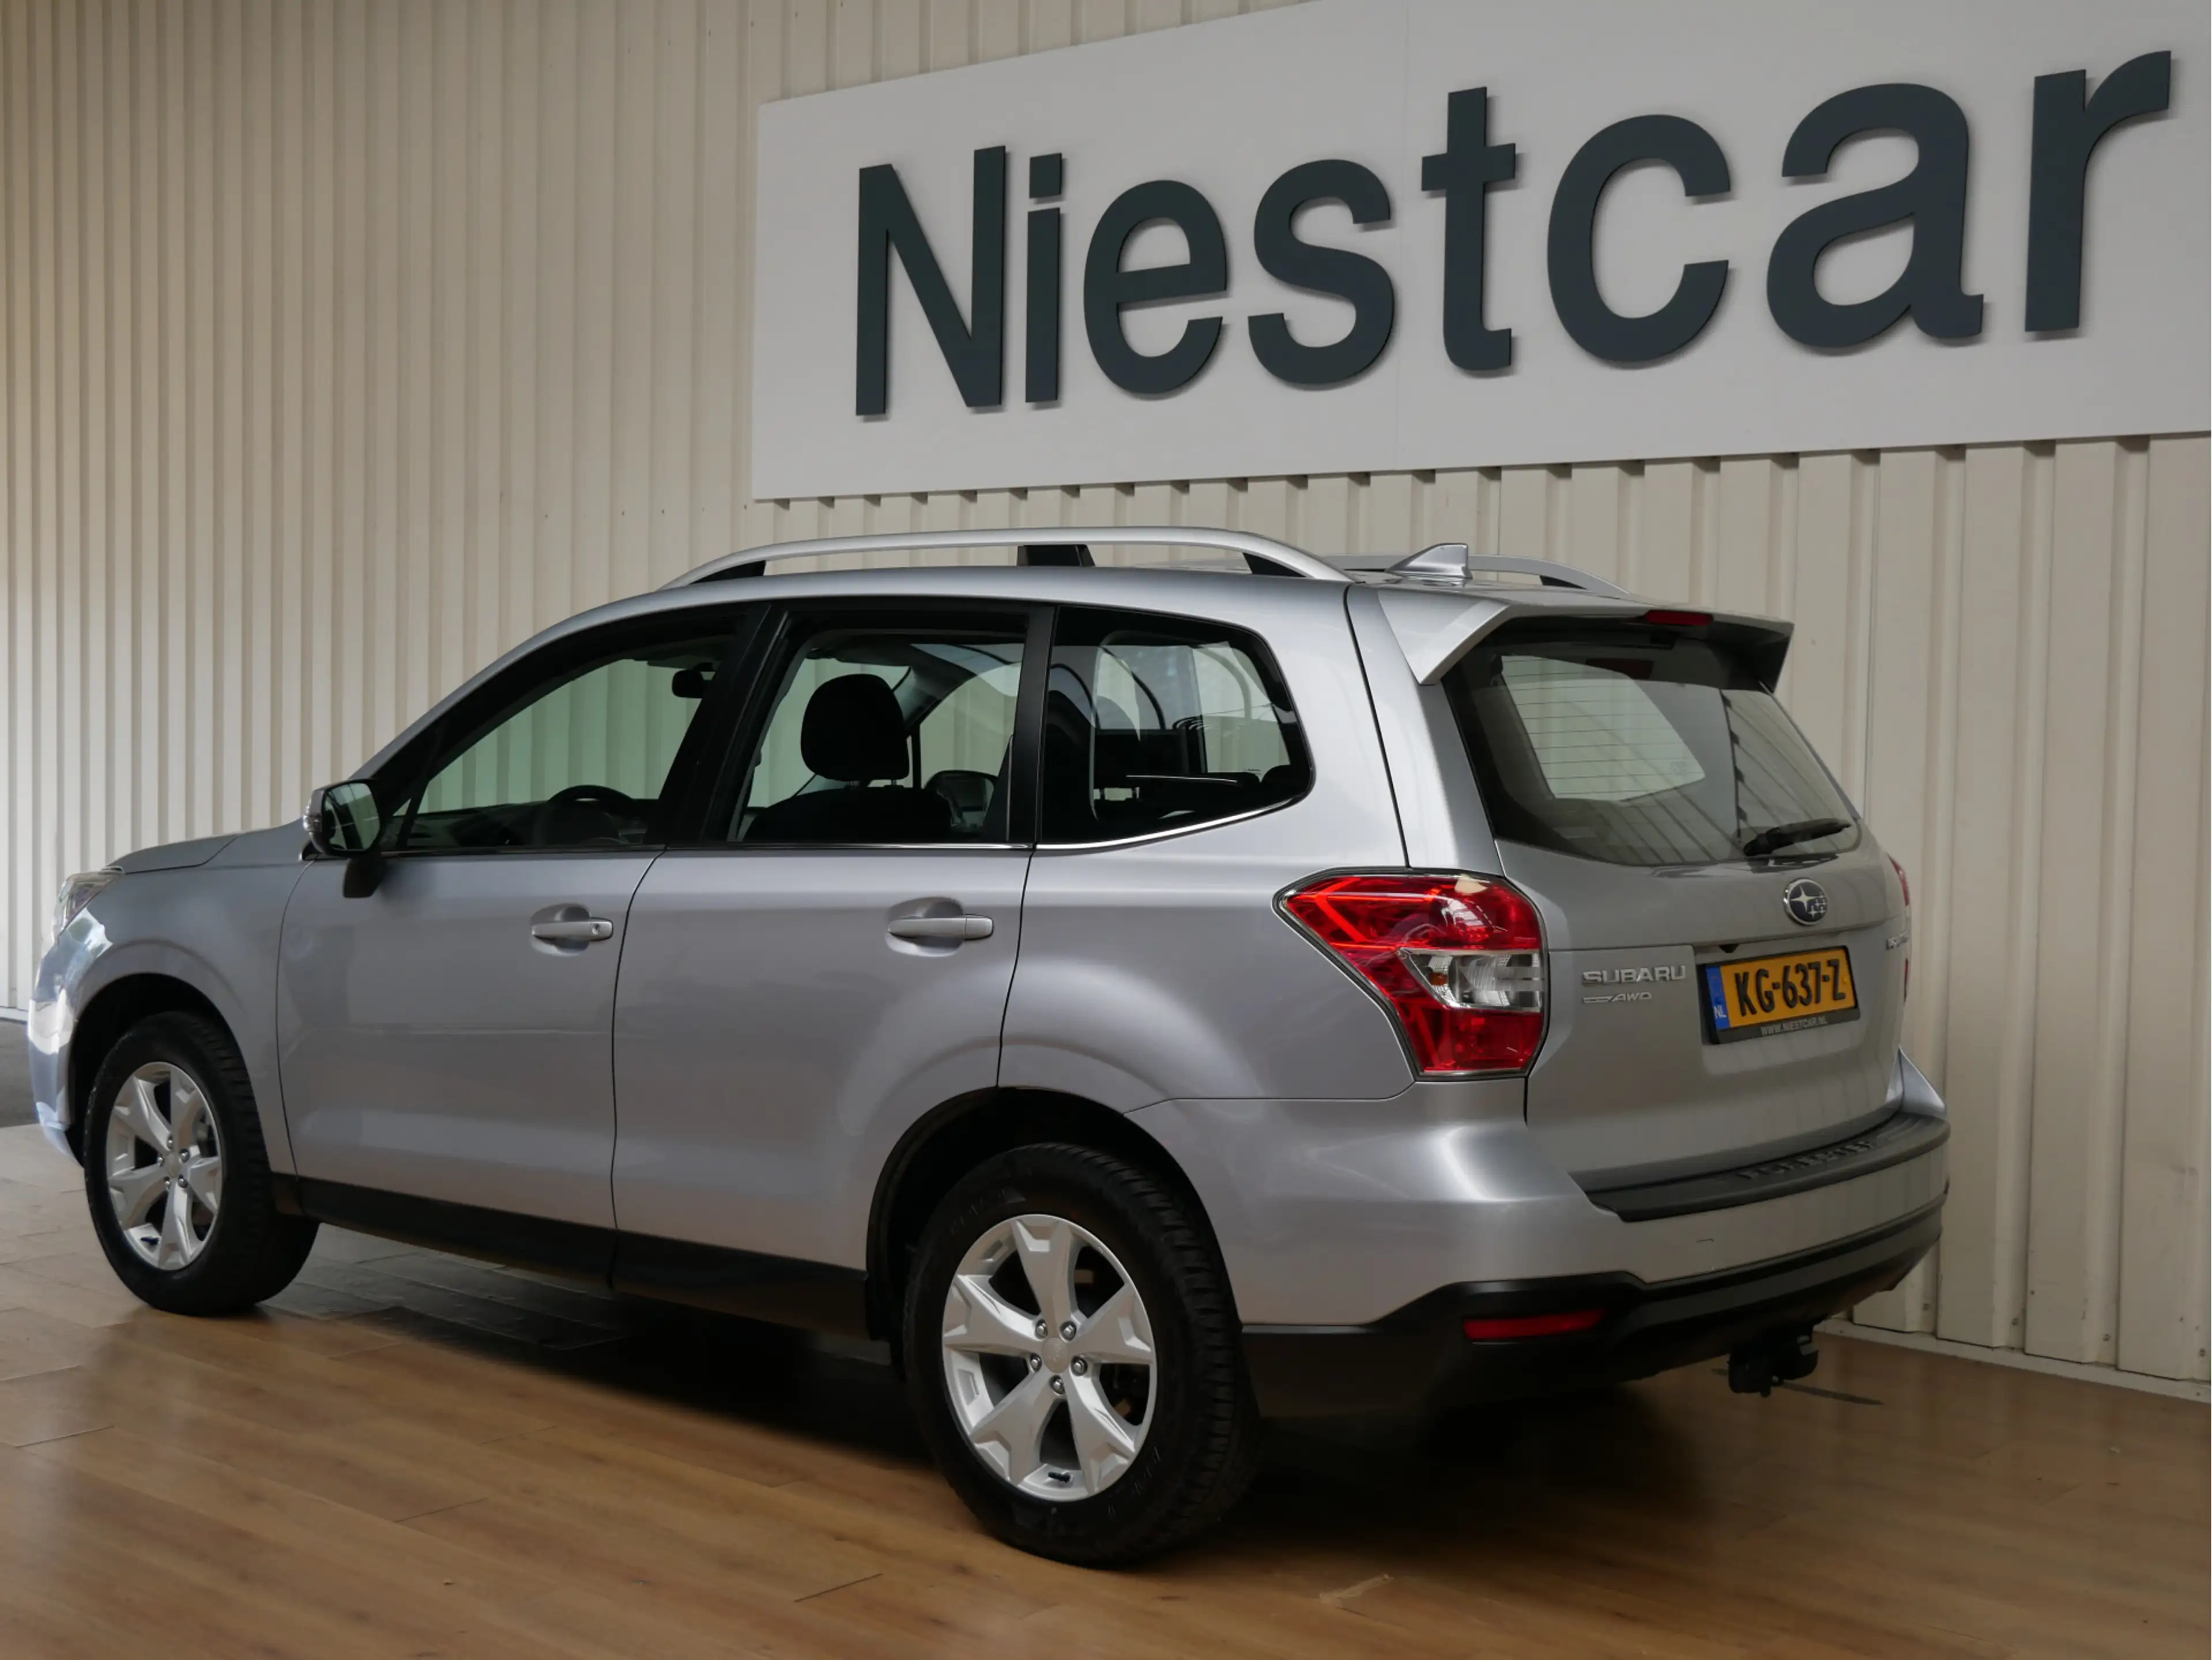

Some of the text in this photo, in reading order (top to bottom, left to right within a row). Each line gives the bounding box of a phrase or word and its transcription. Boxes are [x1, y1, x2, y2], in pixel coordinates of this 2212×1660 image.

[856, 51, 2171, 416] Niestcar
[1582, 965, 1686, 983] SUBARU
[1735, 959, 1845, 1016] KG-637-Z
[1612, 992, 1652, 1002] AWD
[1713, 1005, 1727, 1019] NL
